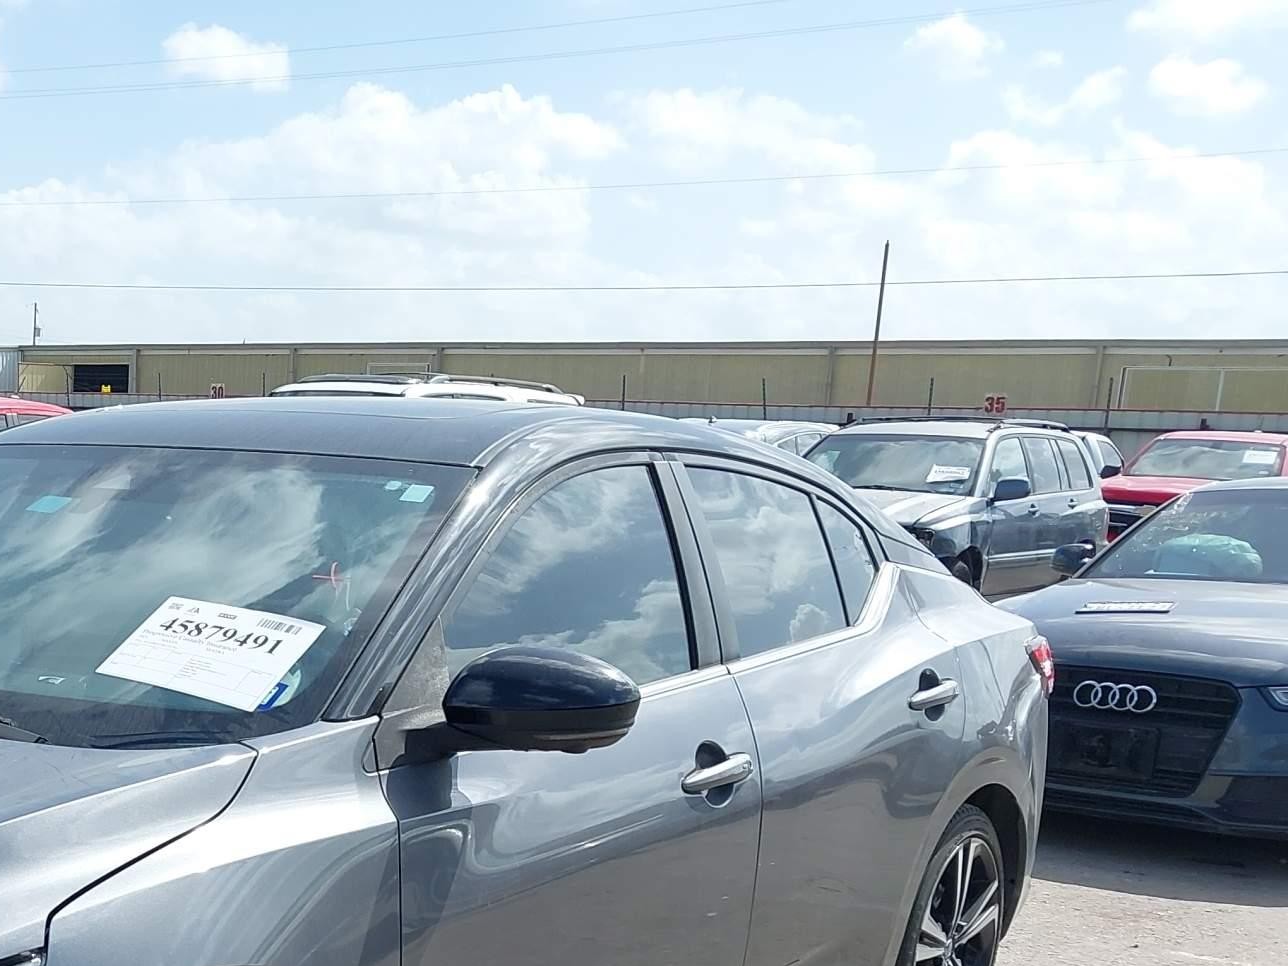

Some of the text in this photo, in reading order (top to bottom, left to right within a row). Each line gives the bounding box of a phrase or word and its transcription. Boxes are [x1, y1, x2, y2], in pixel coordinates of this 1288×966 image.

[211, 385, 224, 399] 30
[984, 396, 1007, 413] 35
[160, 617, 284, 656] 45879491
